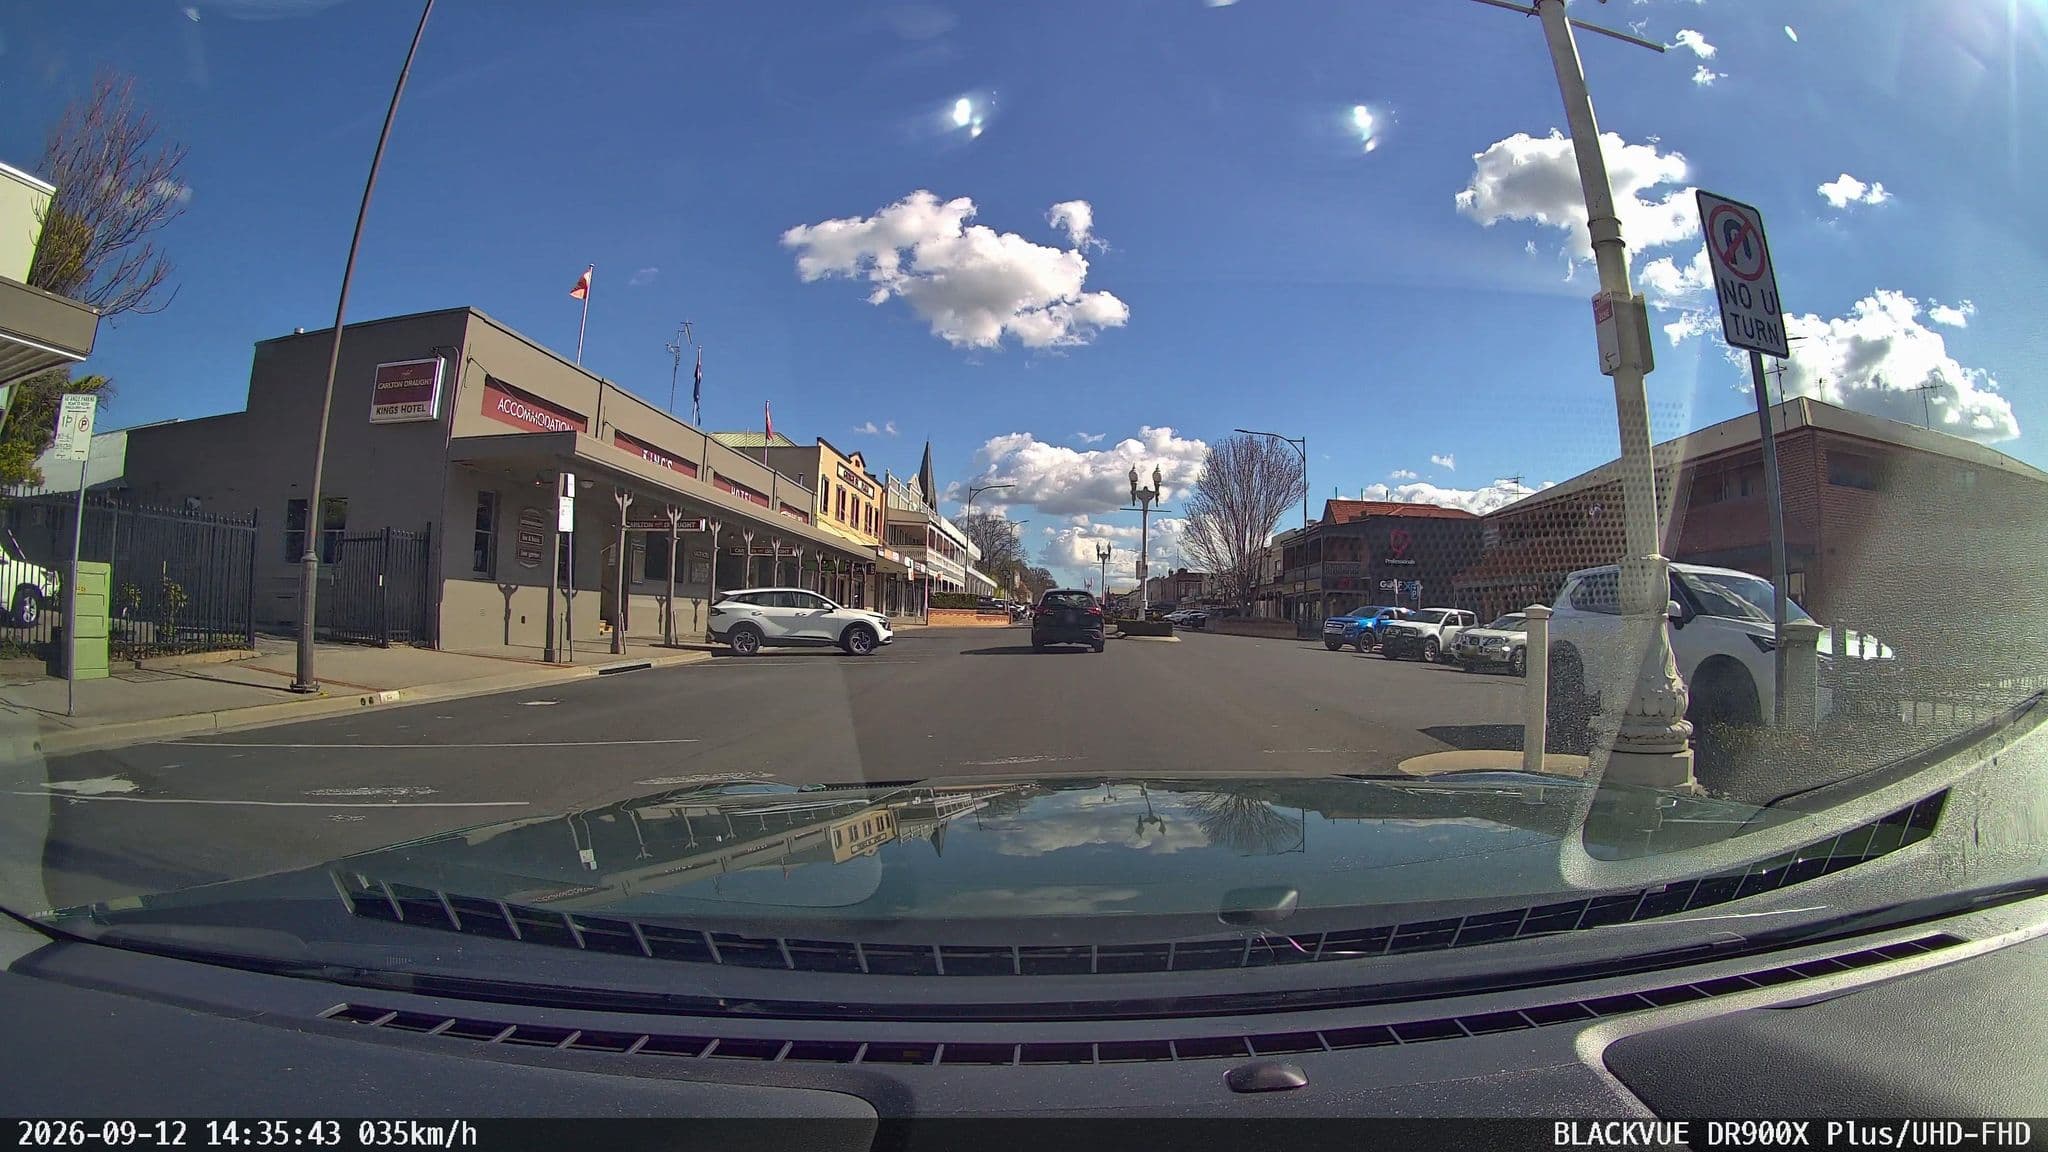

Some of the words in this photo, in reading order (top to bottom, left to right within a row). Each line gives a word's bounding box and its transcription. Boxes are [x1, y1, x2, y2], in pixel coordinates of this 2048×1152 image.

[1720, 278, 1753, 309] NO
[1760, 289, 1777, 316] U
[1730, 312, 1781, 347] TURN
[378, 381, 404, 390] CARLTON
[404, 378, 433, 388] DRAUGHT
[376, 406, 399, 415] KINGS
[401, 404, 426, 414] HOTEL
